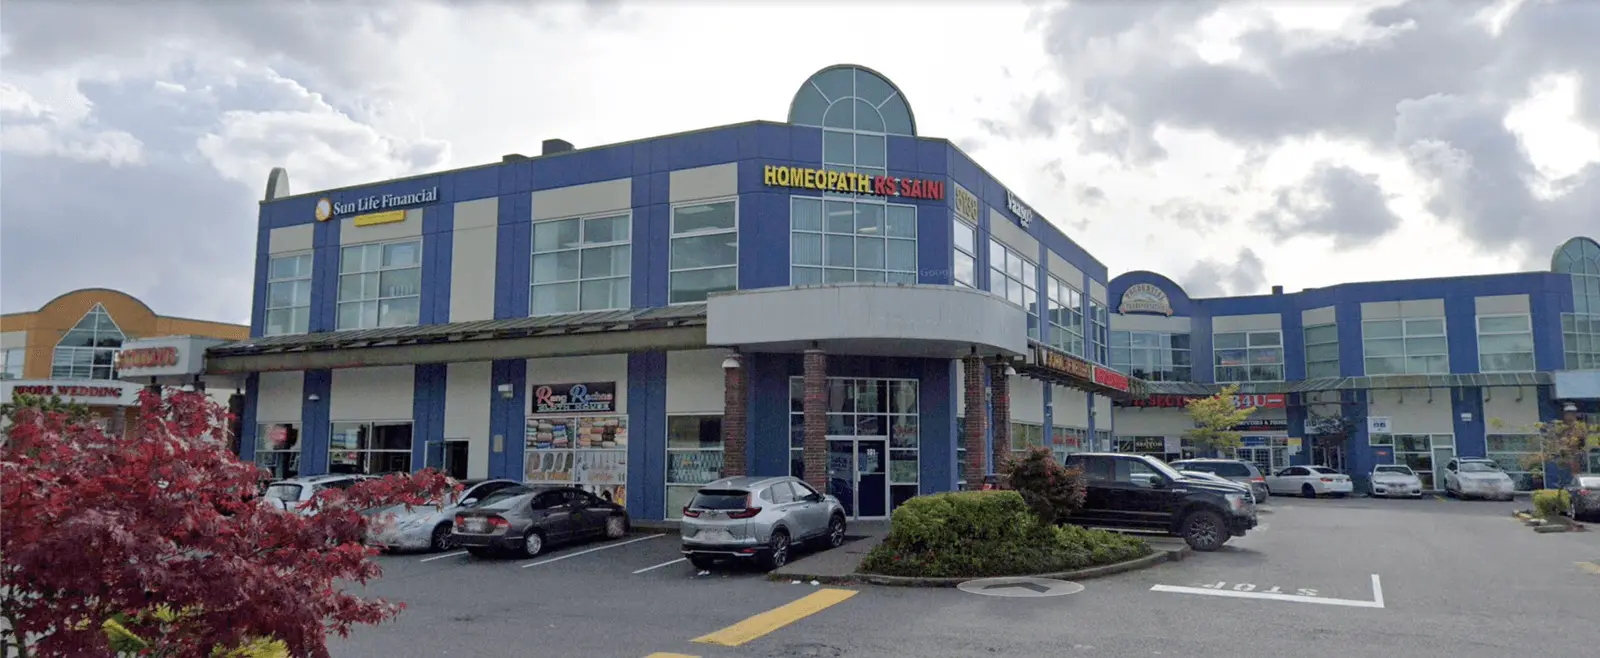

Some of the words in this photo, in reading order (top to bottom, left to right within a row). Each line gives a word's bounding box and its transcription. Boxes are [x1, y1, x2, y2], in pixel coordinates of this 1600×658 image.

[764, 165, 869, 192] HOMEOPATH
[873, 176, 896, 196] RS
[900, 178, 945, 200] SAINI
[333, 201, 356, 215] Sun
[358, 196, 380, 211] Life
[382, 186, 438, 208] Financial
[57, 385, 123, 398] WEDDING
[1201, 581, 1319, 596] STOP
